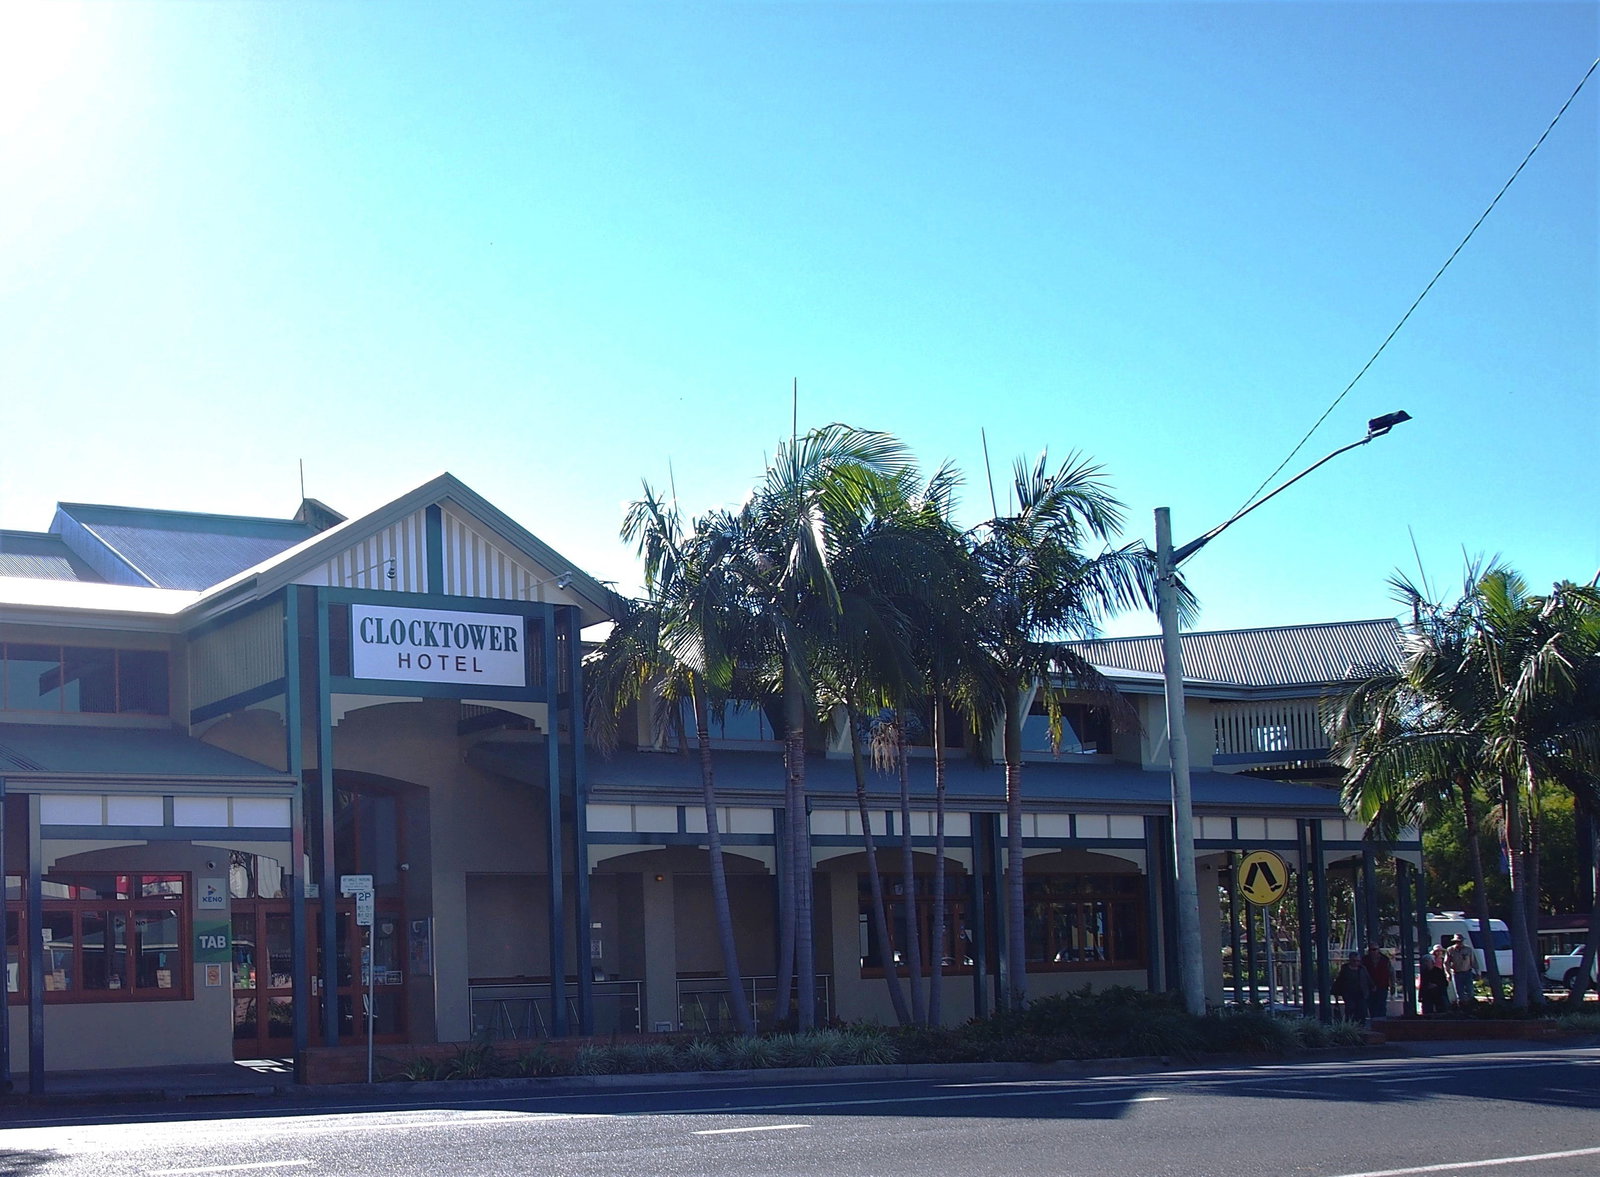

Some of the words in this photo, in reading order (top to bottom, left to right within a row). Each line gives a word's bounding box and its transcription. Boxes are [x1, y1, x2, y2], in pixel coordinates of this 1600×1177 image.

[360, 616, 518, 653] CLOCKTOWER
[398, 653, 483, 673] HOTEL
[358, 892, 371, 901] 2P
[199, 935, 226, 949] TAB
